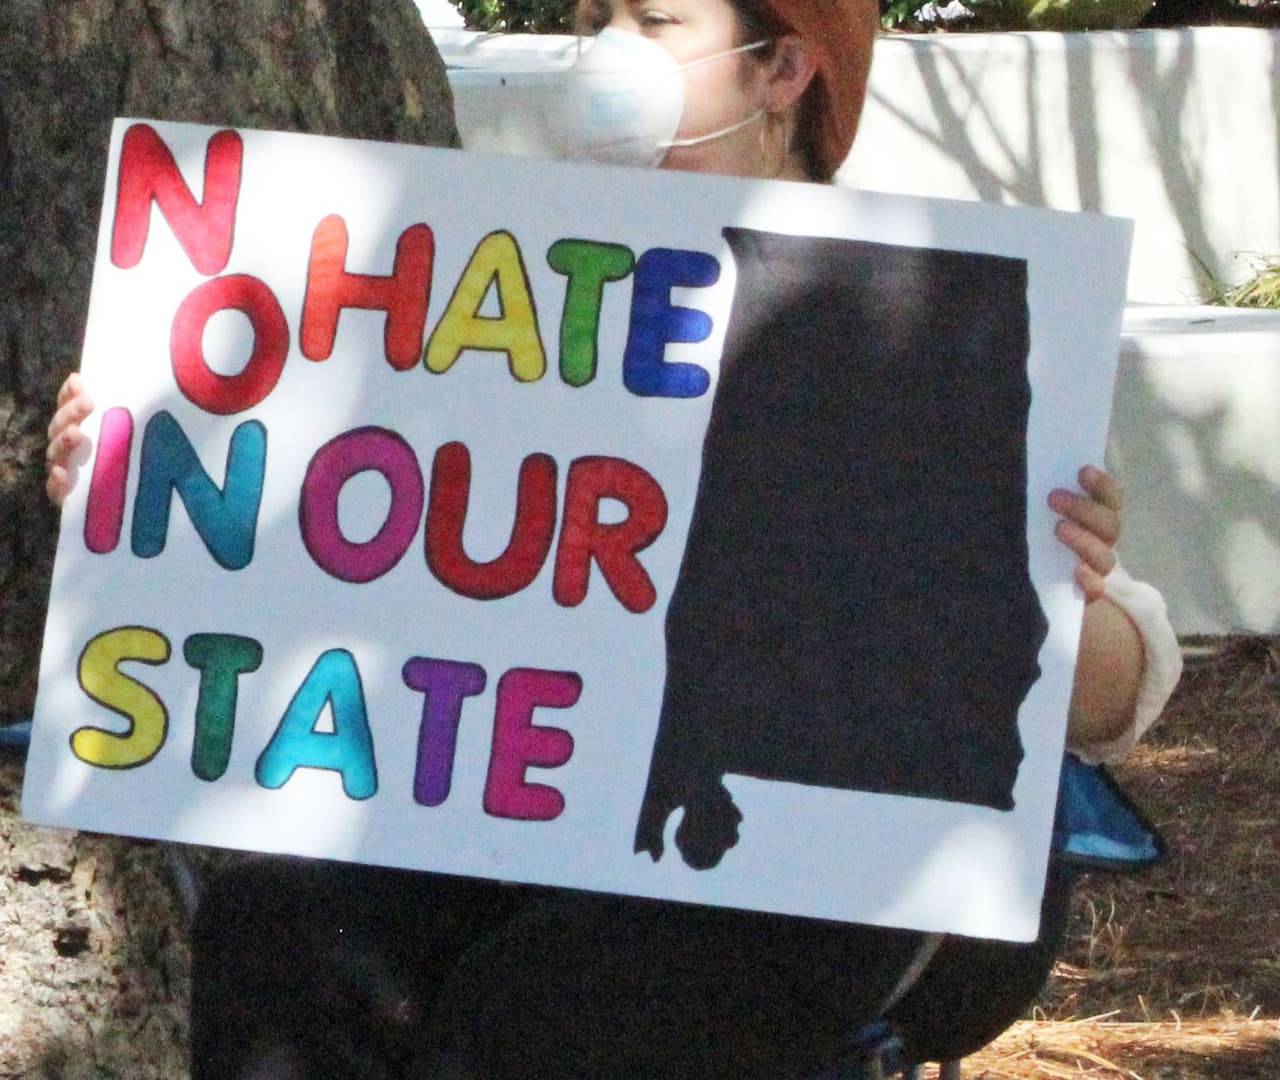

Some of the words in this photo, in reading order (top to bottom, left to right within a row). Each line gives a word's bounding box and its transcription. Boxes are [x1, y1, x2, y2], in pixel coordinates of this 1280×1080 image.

[109, 123, 290, 416] NO
[299, 214, 723, 399] HATE
[82, 407, 268, 571] IN
[298, 425, 670, 615] OUR
[68, 625, 584, 823] STATE
